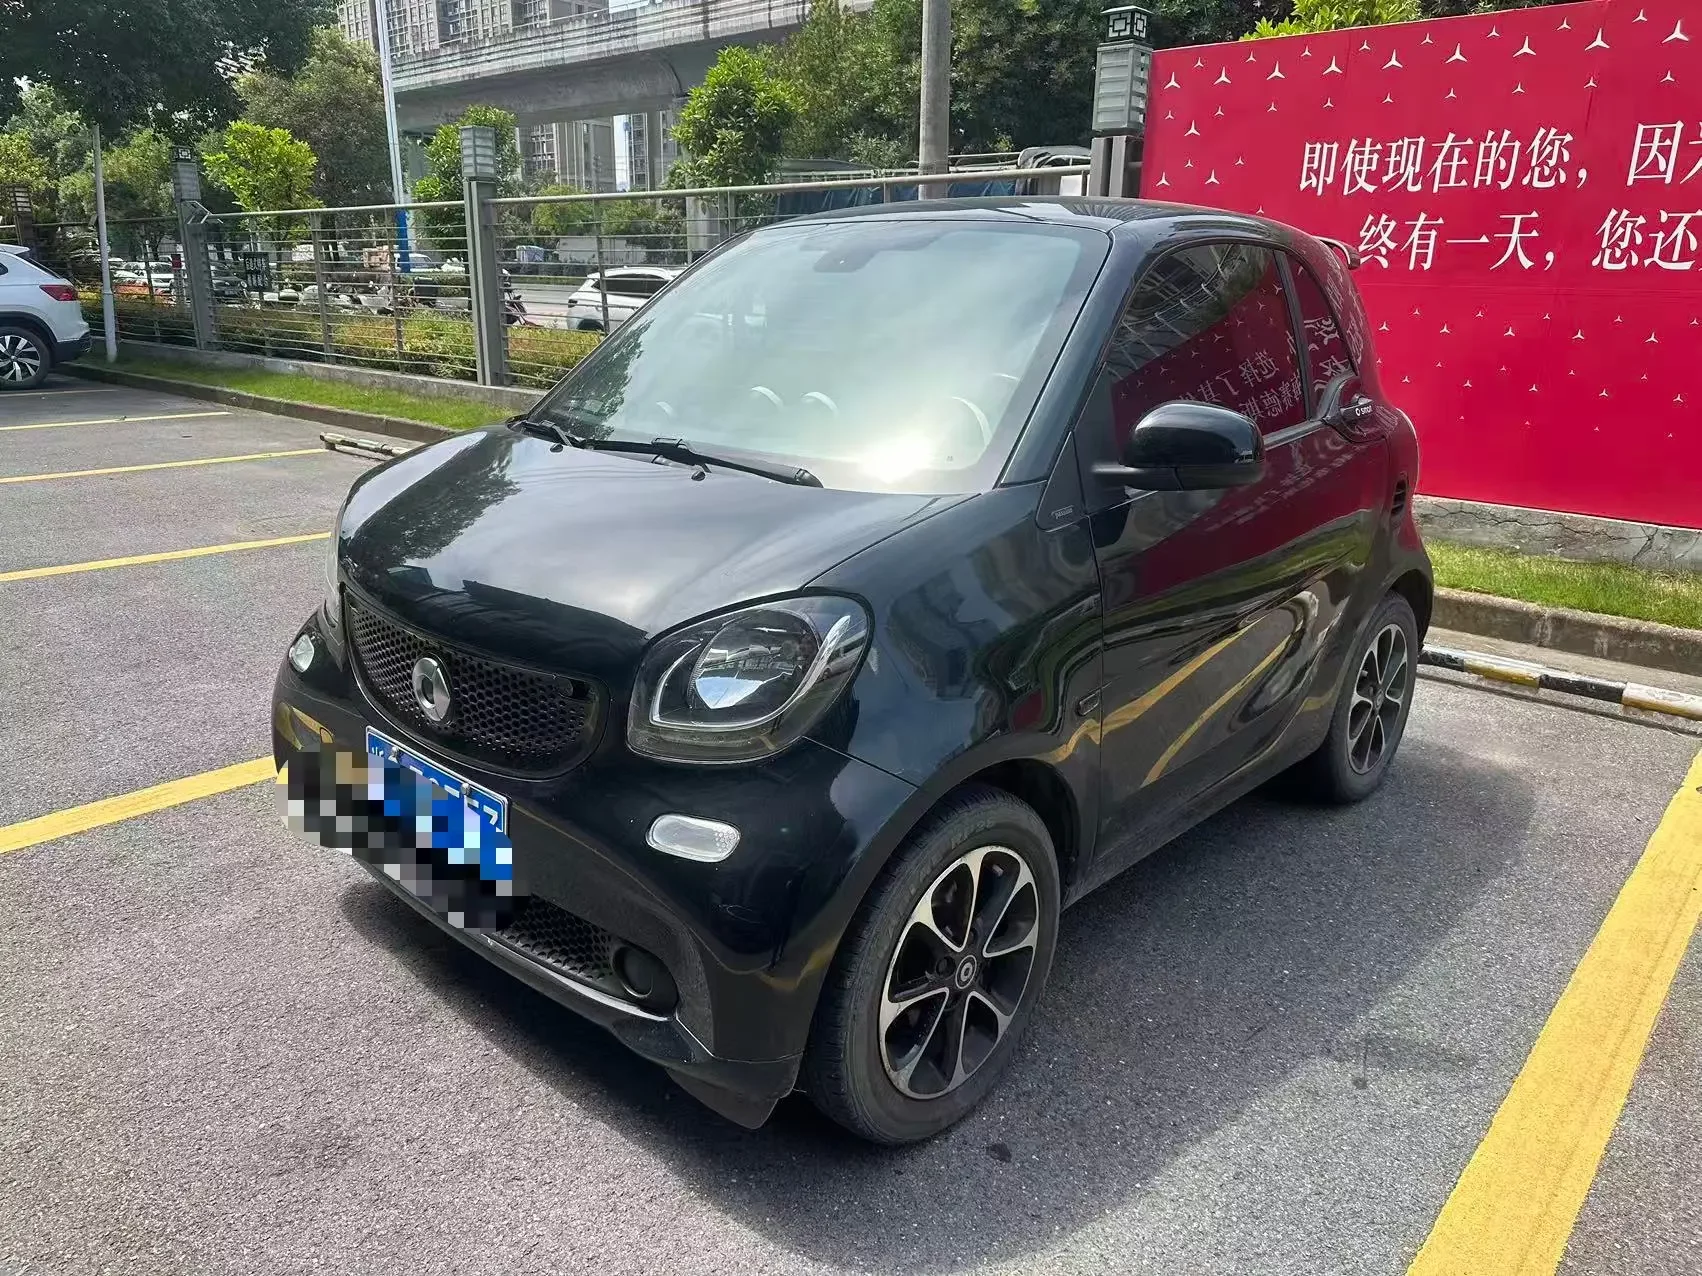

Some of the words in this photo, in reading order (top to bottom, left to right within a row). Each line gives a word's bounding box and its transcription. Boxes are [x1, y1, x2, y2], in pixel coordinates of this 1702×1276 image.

[1358, 207, 1702, 271] 终有一天，您还
